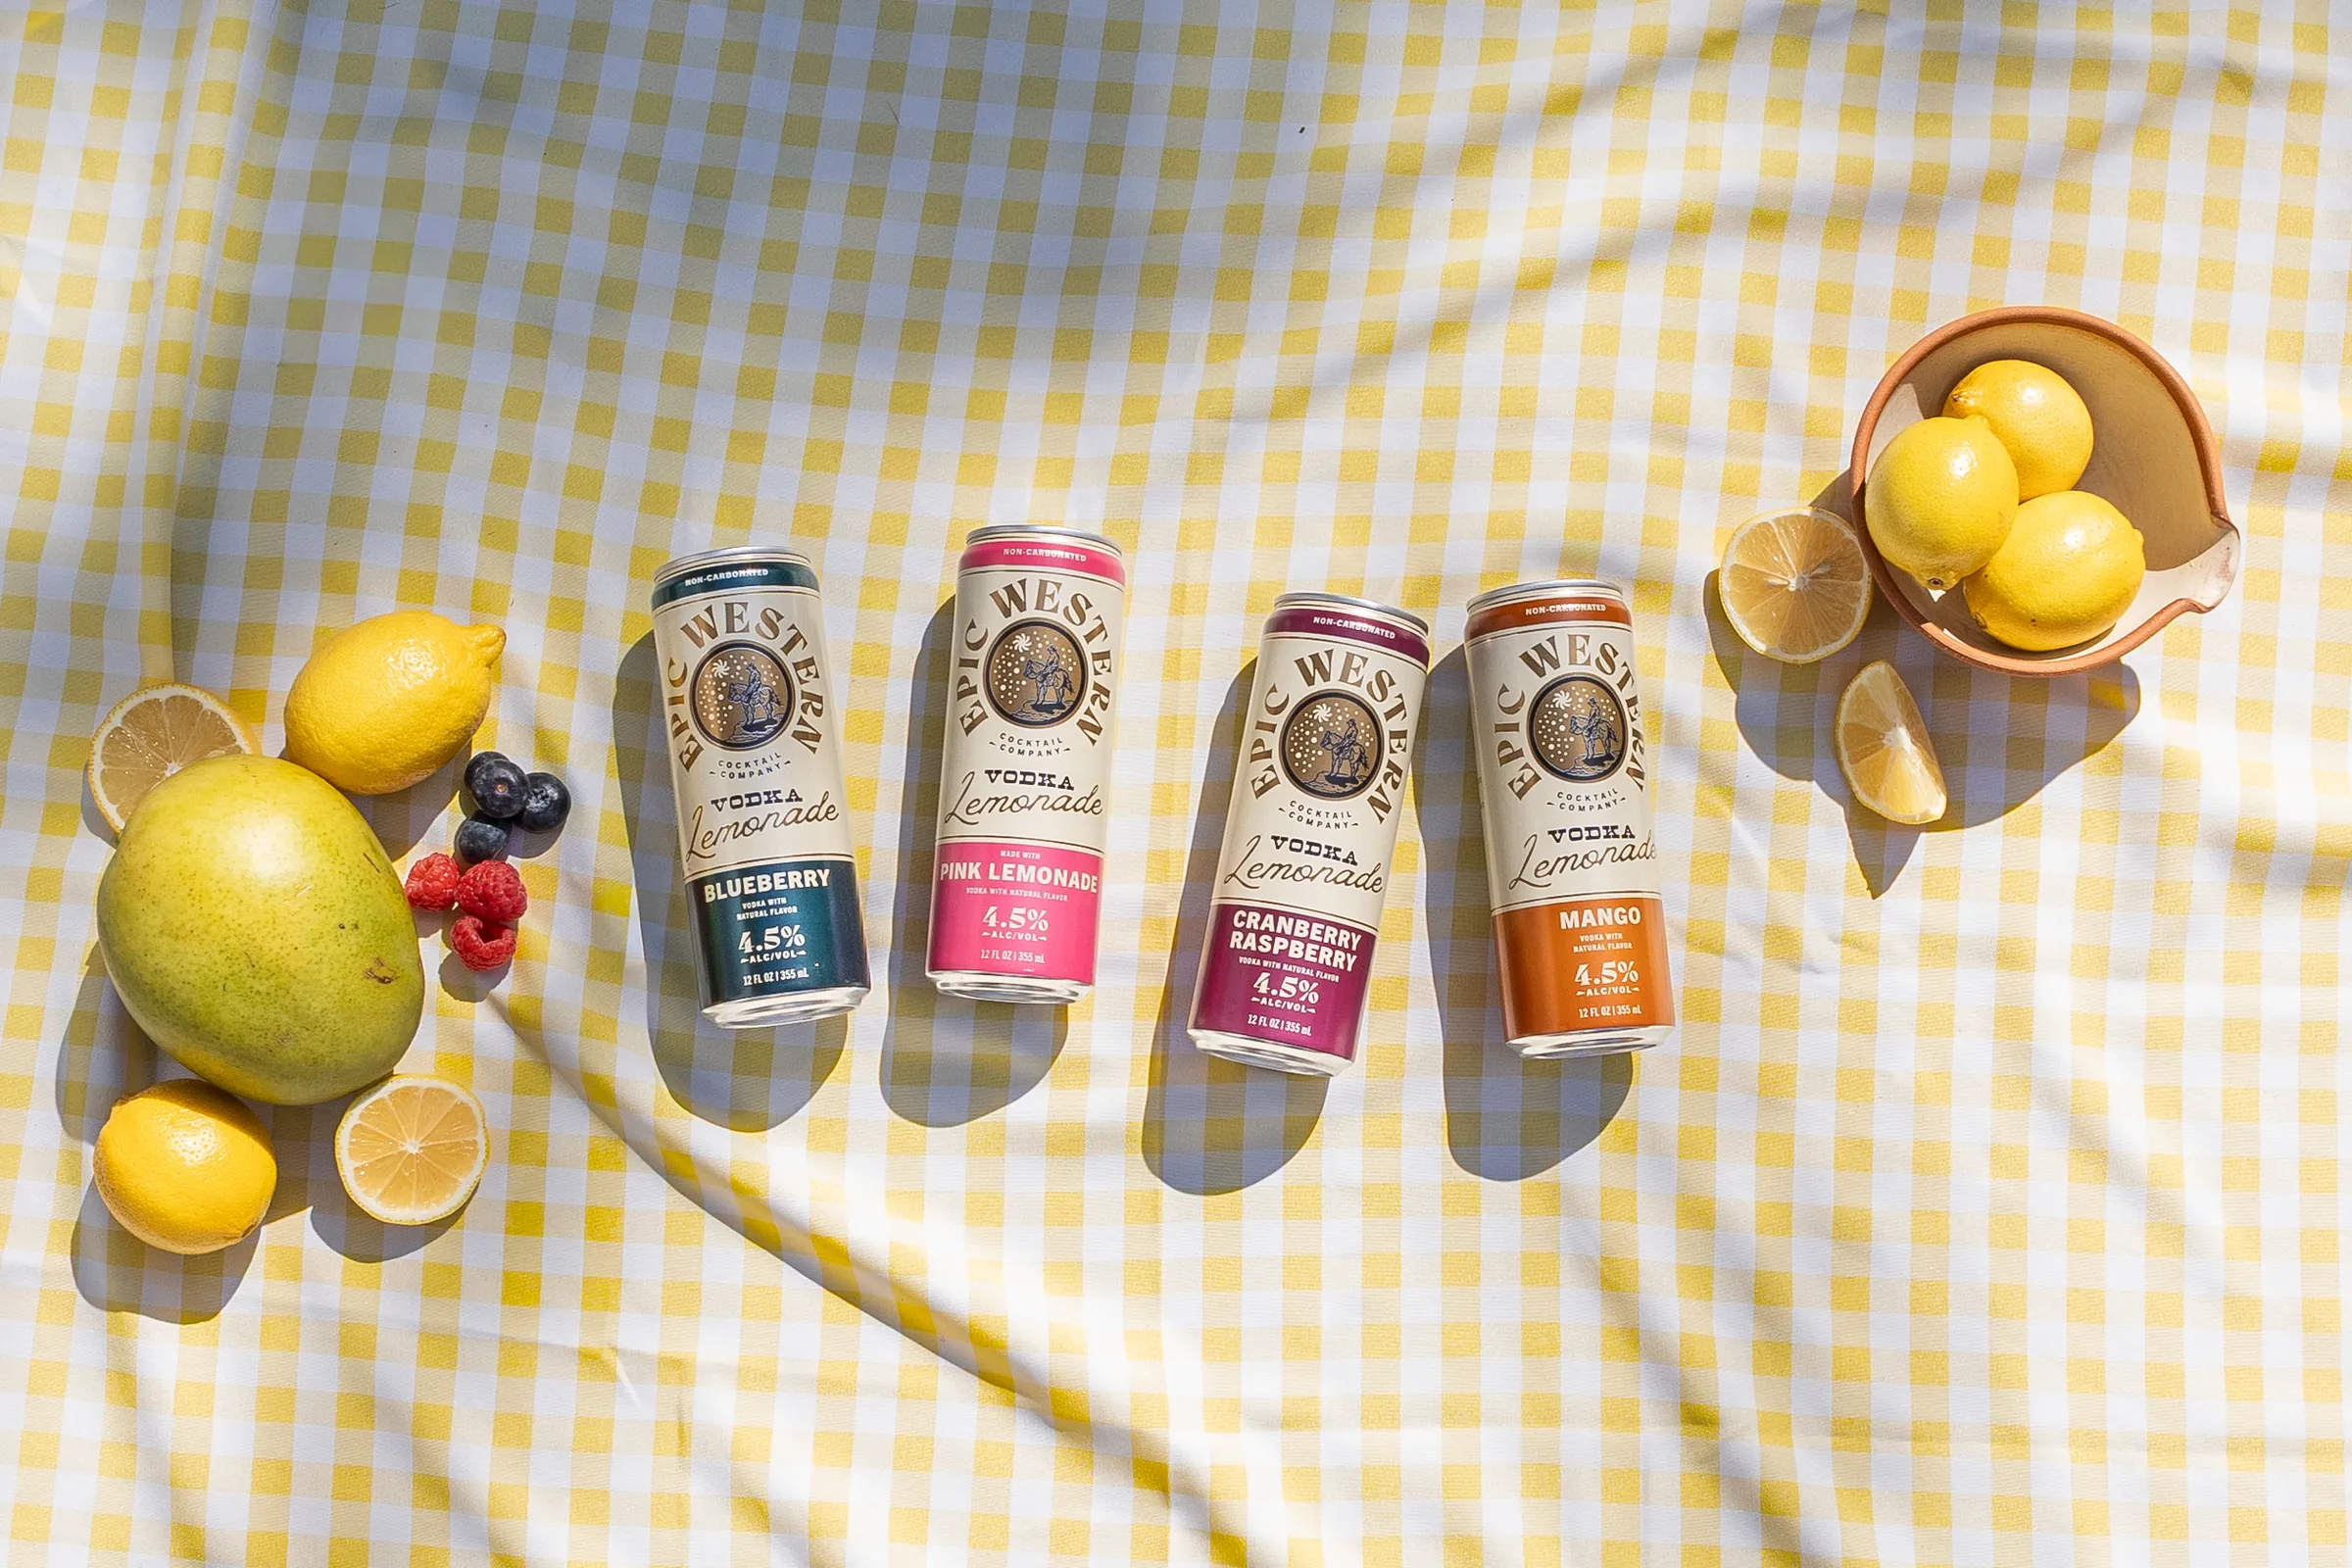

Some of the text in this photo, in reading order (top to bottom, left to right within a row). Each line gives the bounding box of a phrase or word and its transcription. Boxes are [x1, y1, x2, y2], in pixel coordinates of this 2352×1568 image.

[1003, 548, 1087, 563] NON-CARBONATED
[684, 568, 769, 586] NON-CARBONATED
[1525, 603, 1606, 615] NON-CARBONATED
[1312, 616, 1396, 639] NON-CARBONATED
[956, 577, 1112, 747] EPIC WESTERN
[667, 602, 824, 772] EPIC WESTERN
[1494, 634, 1645, 801] EPIC WESTERN
[1000, 732, 1063, 748] COCKTAIL
[1250, 649, 1408, 825] EPIC WESTERN
[1000, 744, 1060, 758] COMPANY
[717, 753, 782, 769] COCKTAIL
[720, 762, 781, 779] COMPANY
[984, 769, 1075, 791] VODKA
[710, 789, 803, 812] VODKA
[944, 771, 1103, 825] Lemonade
[1556, 788, 1618, 802] COCKTAIL
[1290, 800, 1352, 819] COCKTAIL
[1559, 799, 1618, 812] COMPANY
[686, 791, 839, 862] Lemonade
[1289, 811, 1348, 829] COMPANY
[1547, 824, 1636, 844] VODKA
[1000, 850, 1041, 859] MADE WITH
[1270, 835, 1358, 866] VODKA
[1224, 835, 1383, 893] Lemonade
[704, 868, 830, 904] BLUEBERRY
[940, 861, 1099, 894] PINK LEMONADE
[742, 897, 787, 909] VODKA WITH
[1009, 889, 1041, 899] NATURAL
[1043, 892, 1068, 902] FLAVOR
[736, 906, 798, 921] NATURAL FLAVOR
[982, 906, 1050, 931] 4.5%
[1559, 906, 1642, 930] MANGO
[738, 925, 806, 954] 4.5%
[991, 931, 1039, 941] ALC/VOL
[1233, 909, 1362, 952] CRANBERRY
[1579, 933, 1604, 942] VODKA
[750, 952, 797, 963] ALC/VOL
[980, 950, 989, 959] 12
[991, 950, 1001, 959] FL
[1002, 951, 1012, 960] OZ
[1018, 952, 1033, 962] 355
[1034, 953, 1046, 964] mL
[1229, 930, 1357, 972] RASPBERRY
[1573, 944, 1606, 953] NATURAL
[743, 975, 753, 986] 12
[754, 973, 763, 984] FL
[764, 972, 775, 983] OZ
[780, 969, 797, 981] 355
[797, 967, 809, 979] mL
[1239, 956, 1340, 983] VODKA WITH NATURAL FLAVOR
[1574, 960, 1639, 986] 4.5%
[1252, 971, 1319, 1004] 4.5%
[1586, 986, 1632, 997] ALC/VOL
[1260, 997, 1307, 1013] ALC/VOL
[1578, 1008, 1589, 1018] 12
[1590, 1006, 1599, 1017] FL
[1600, 1006, 1611, 1016] OZ
[1616, 1004, 1631, 1015] 355
[1632, 1004, 1642, 1014] mL
[1247, 1014, 1257, 1025] 12
[1258, 1015, 1268, 1027] FL
[1269, 1018, 1280, 1029] OZ
[1285, 1020, 1300, 1033] 355
[1301, 1024, 1312, 1036] mL
